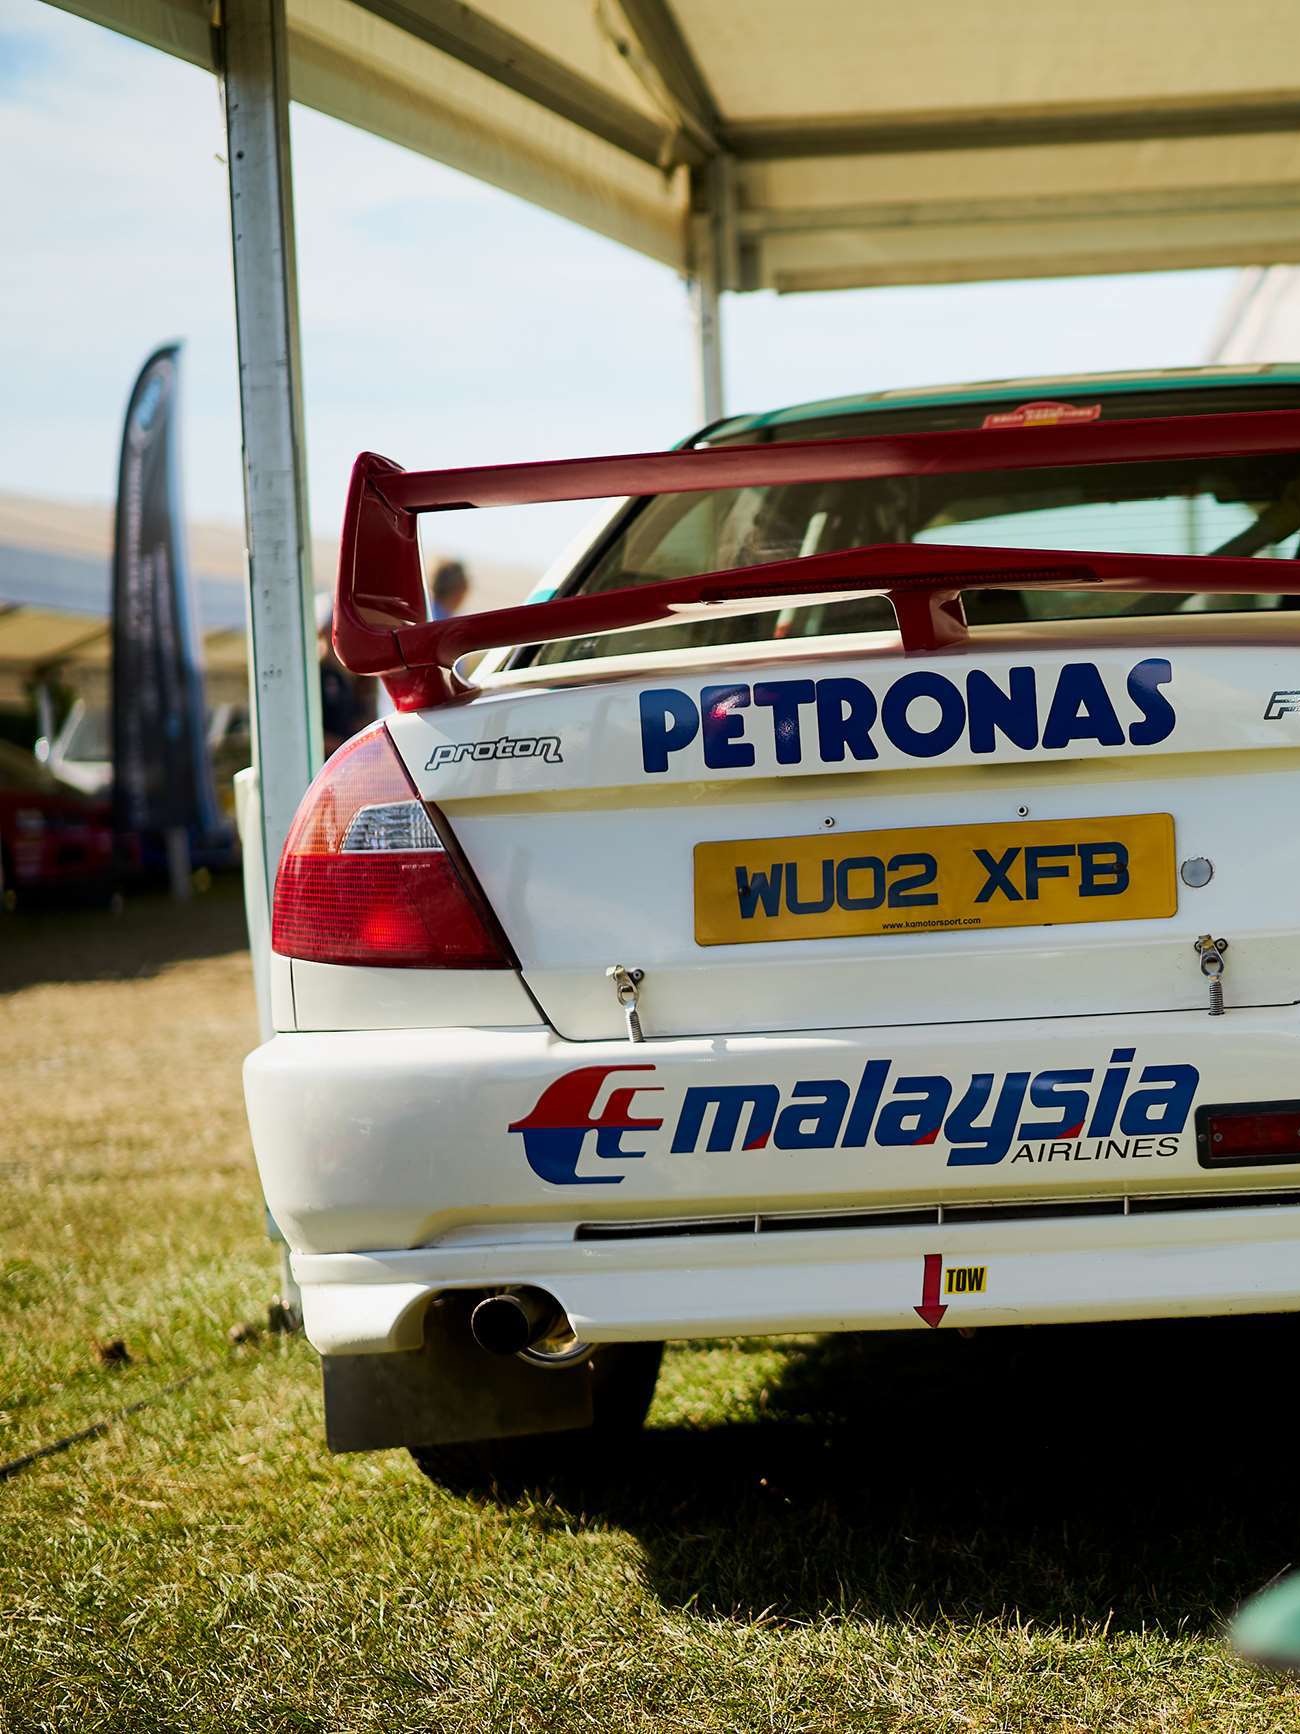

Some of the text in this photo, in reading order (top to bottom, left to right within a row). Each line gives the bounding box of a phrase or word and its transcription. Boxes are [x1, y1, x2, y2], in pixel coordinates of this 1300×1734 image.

[638, 657, 1177, 774] PETRONAS
[425, 736, 564, 771] proton
[736, 841, 1130, 920] WU02 XFB
[670, 1047, 1200, 1168] malaysia
[1011, 1136, 1181, 1165] AIRLINES
[946, 1267, 985, 1293] TOW
